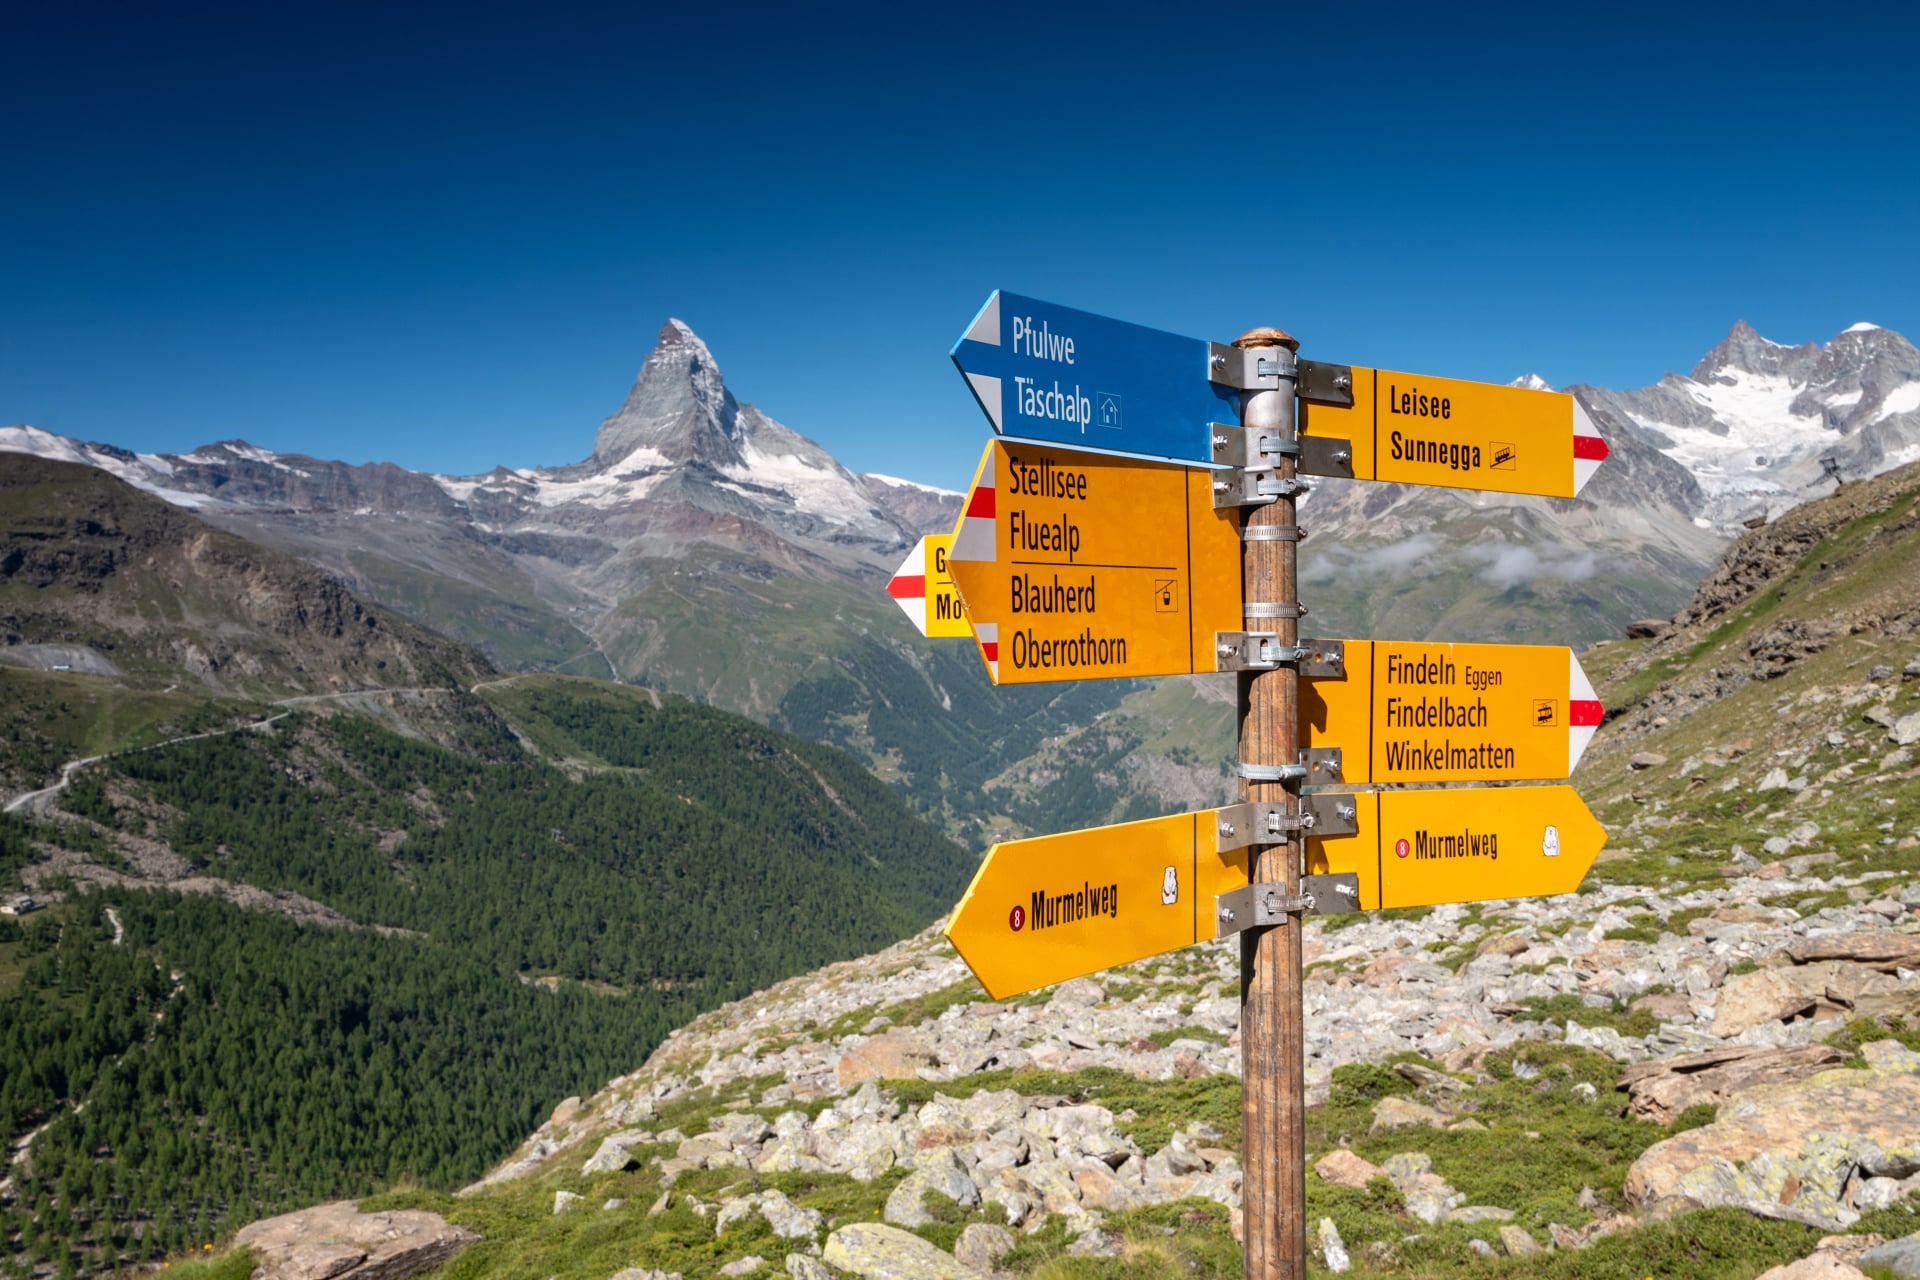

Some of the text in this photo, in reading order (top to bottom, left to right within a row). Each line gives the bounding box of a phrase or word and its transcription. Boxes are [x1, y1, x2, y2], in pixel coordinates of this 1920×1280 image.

[1013, 316, 1075, 365] Pfulwe
[1014, 376, 1091, 434] Täschalp
[1390, 384, 1451, 420] Leisee
[1391, 430, 1481, 471] Sunnegga
[1009, 456, 1087, 501] Stellisee
[1010, 511, 1080, 562] Fluealp
[1011, 574, 1096, 614] Blauherd
[1012, 627, 1127, 669] Oberrothorn
[1388, 654, 1502, 691] Findeln Eggen
[1387, 697, 1487, 728] Findelbach
[1385, 739, 1515, 771] Winkelmatten
[1415, 828, 1498, 860] Murmelweg
[1031, 881, 1118, 931] Murmelweg
